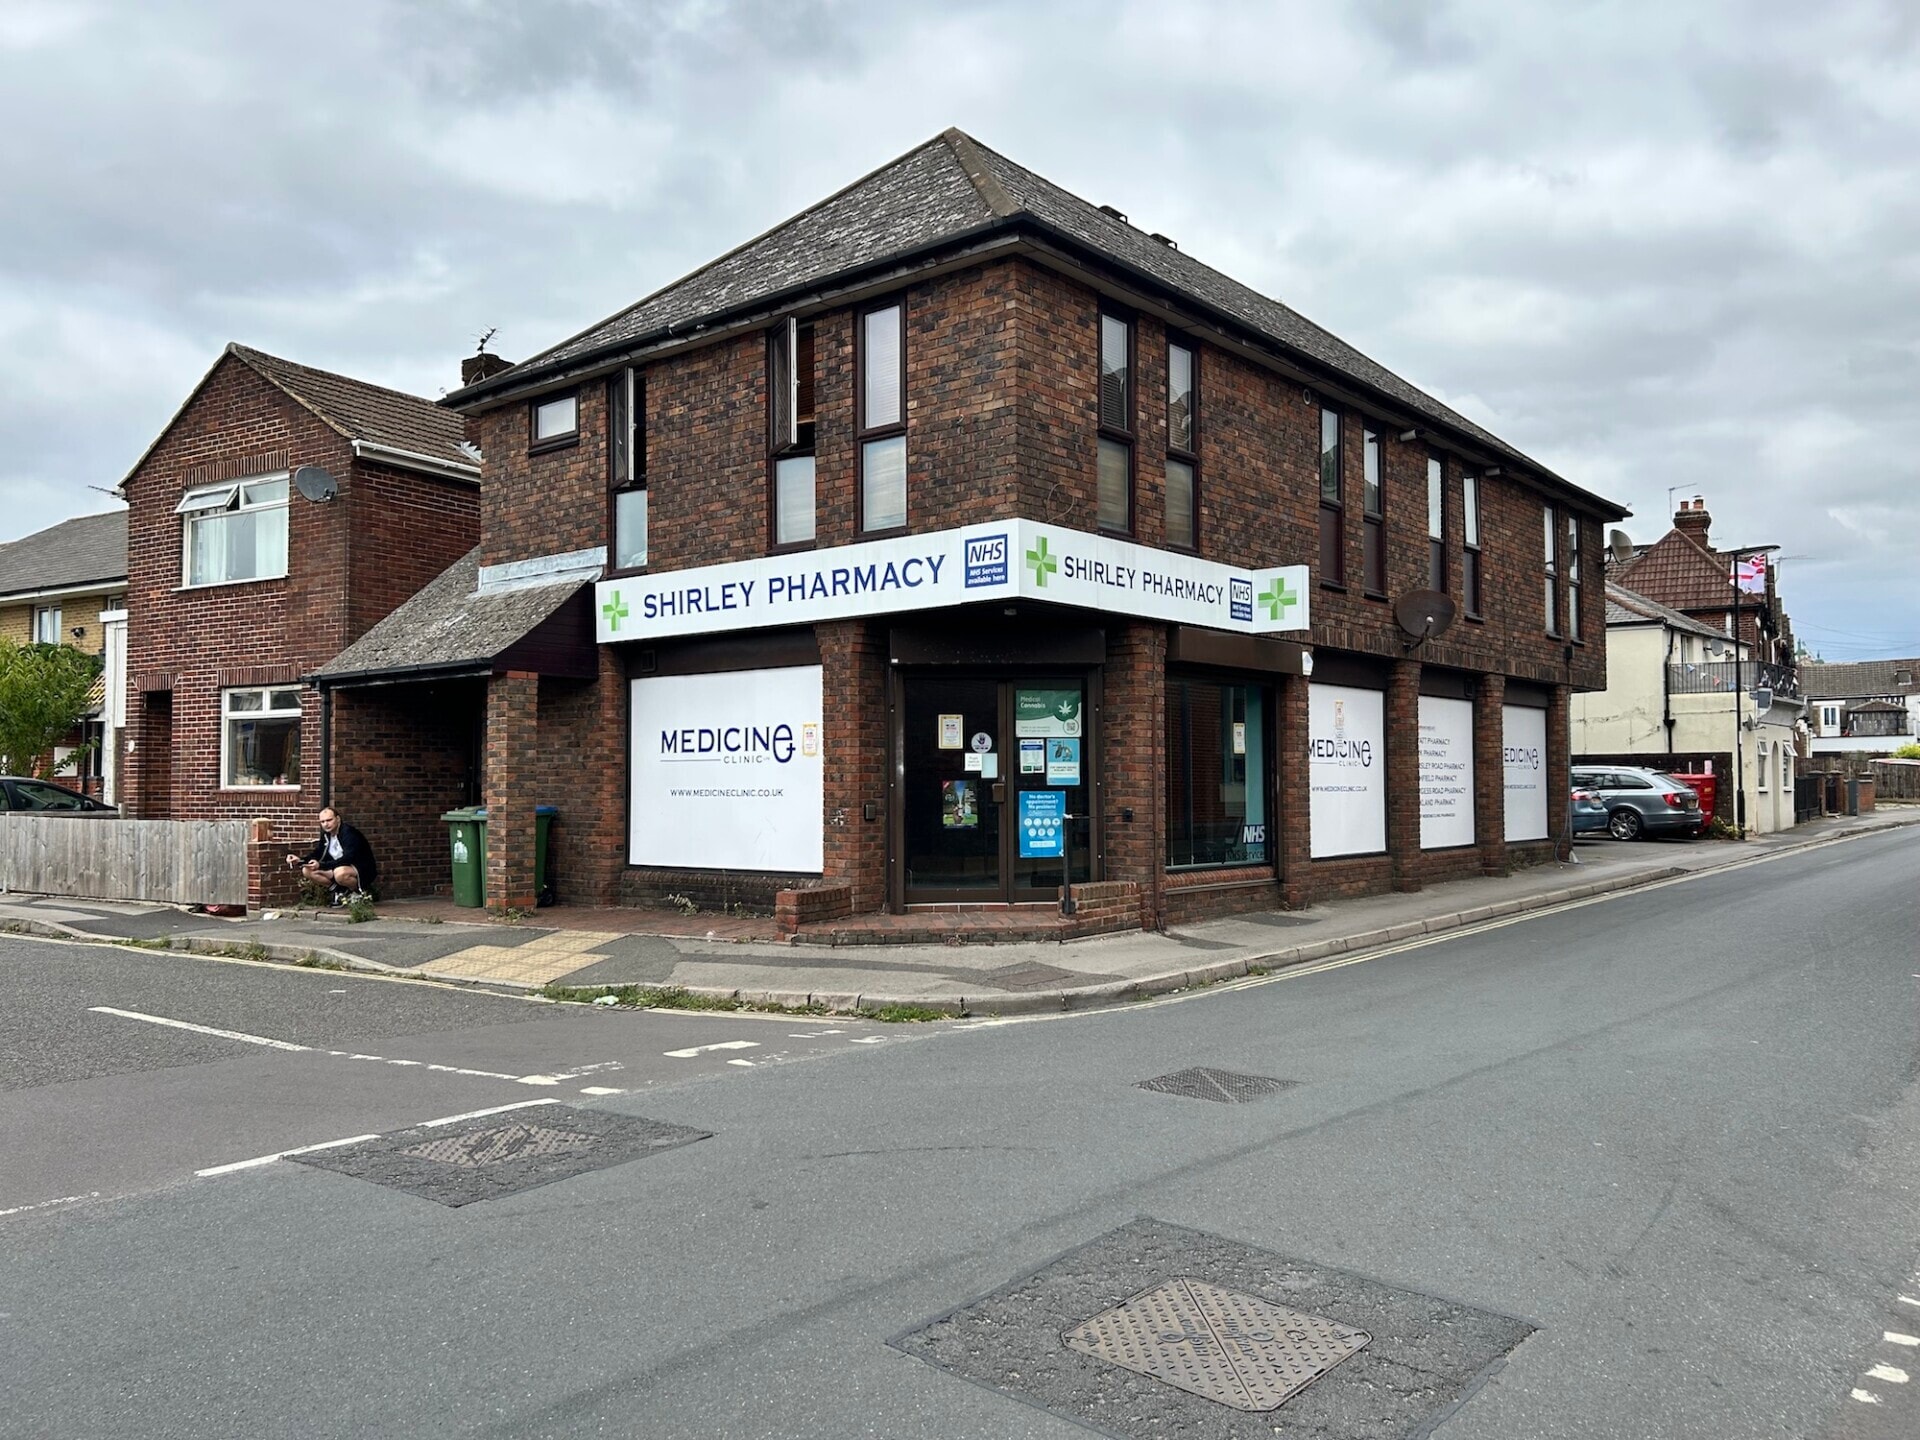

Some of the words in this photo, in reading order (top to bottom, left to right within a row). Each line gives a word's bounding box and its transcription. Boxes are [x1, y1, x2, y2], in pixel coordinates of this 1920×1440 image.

[969, 541, 1003, 563] NHS
[969, 567, 981, 576] NHS
[982, 566, 1004, 575] Services
[968, 575, 992, 585] available
[992, 574, 1006, 582] here
[1064, 556, 1136, 590] SHIRLEY
[1143, 572, 1223, 605] PHARMACY
[644, 581, 754, 619] SHIRLEY
[768, 554, 946, 604] PHARMACY
[1232, 584, 1250, 601] NHS
[1427, 737, 1450, 745] PHARMACY
[723, 755, 763, 764] CLINIC
[670, 788, 784, 797] WWW.MEDICINECLINIC.CO.UK
[1444, 787, 1466, 795] PHARMACY
[1434, 798, 1456, 806] PHARMACY
[1243, 825, 1265, 844] NHS
